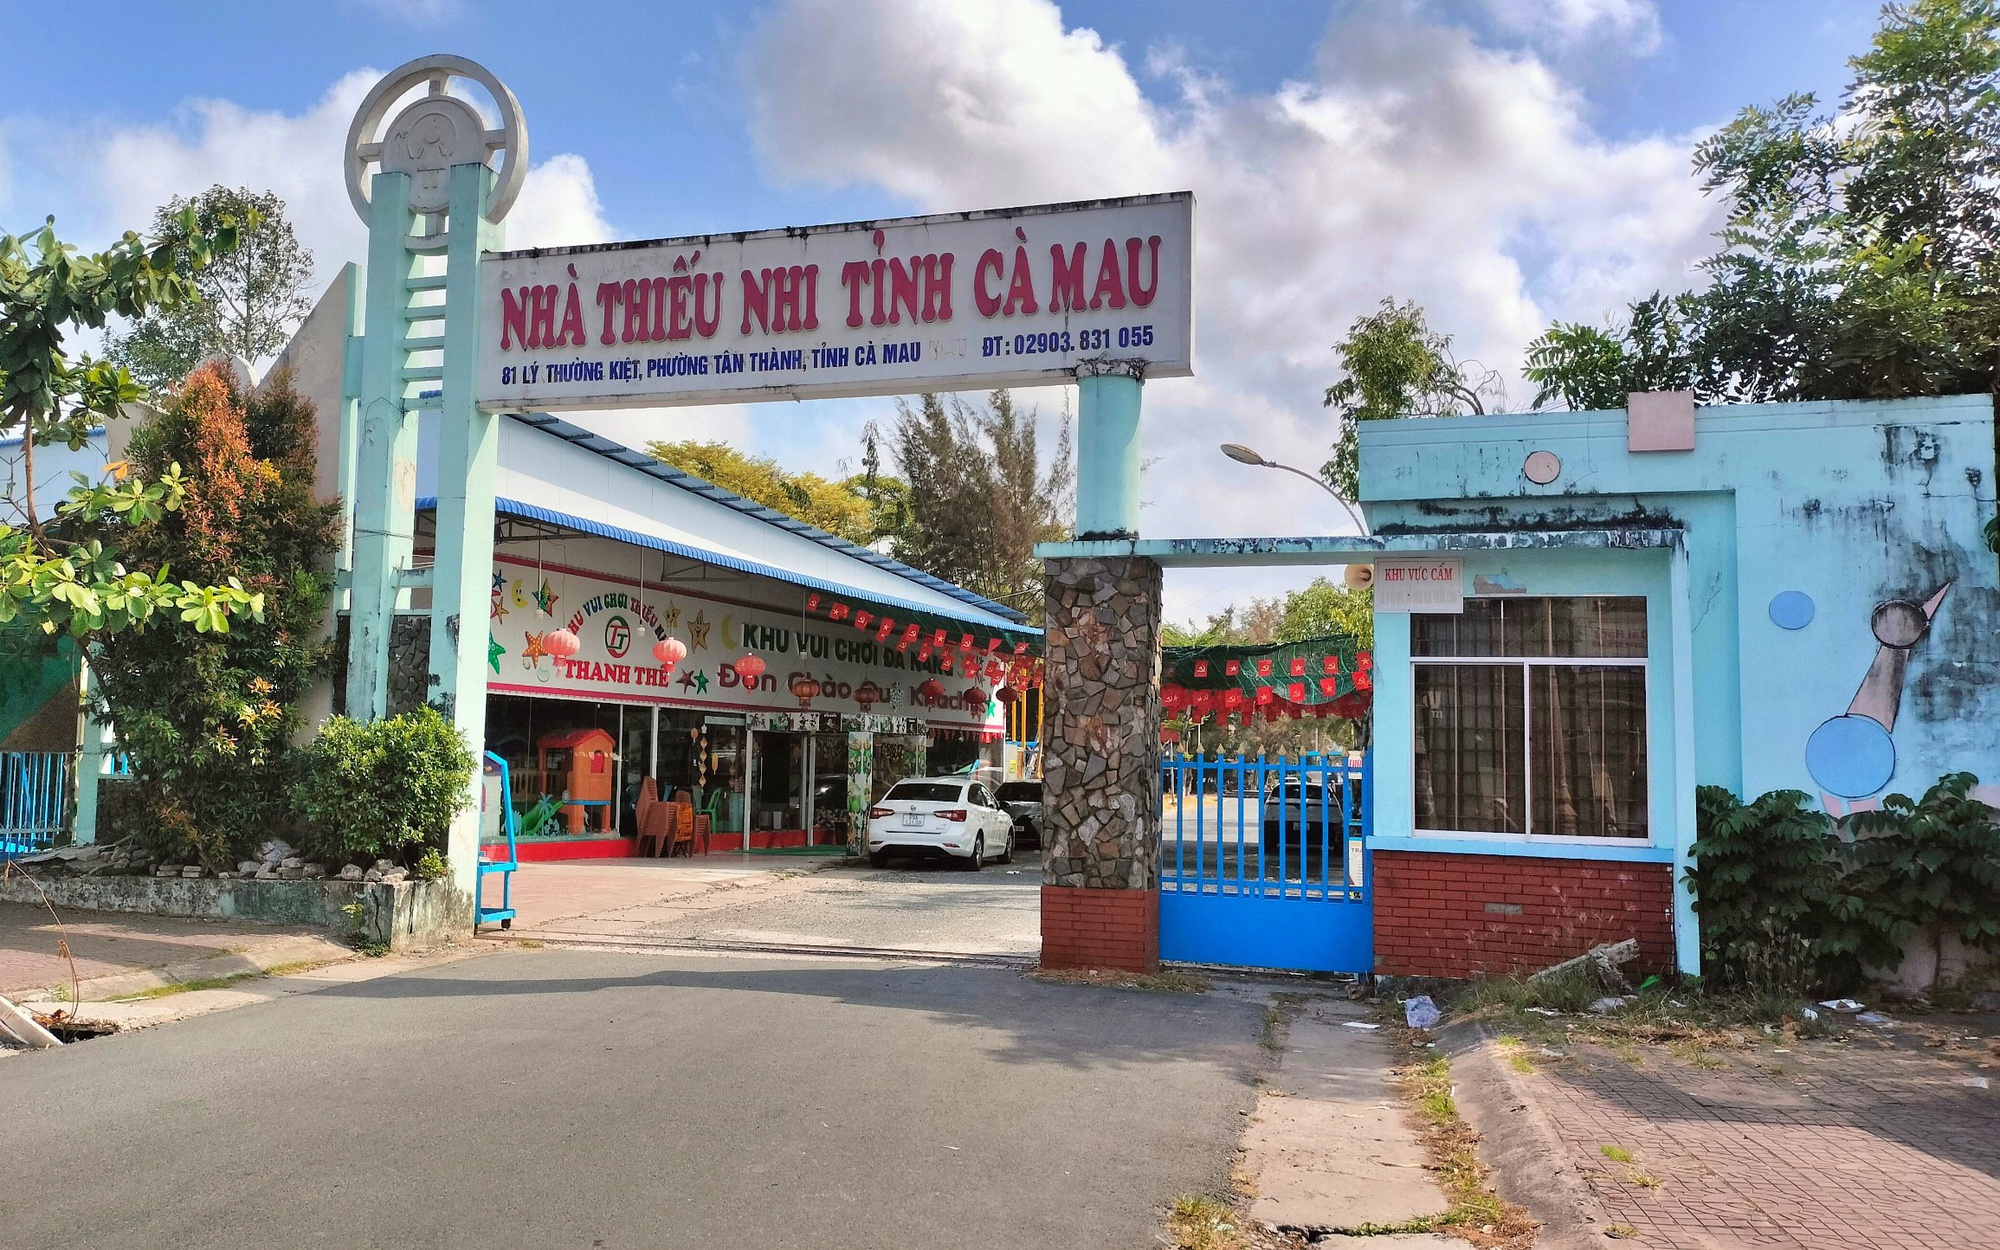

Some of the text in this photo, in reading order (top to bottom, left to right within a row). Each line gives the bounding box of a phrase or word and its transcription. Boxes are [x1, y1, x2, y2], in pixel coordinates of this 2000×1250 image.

[501, 226, 1162, 351] NHÀ THIẾU NHI TỈNH CÀ MAU
[1118, 325, 1153, 348] 055
[502, 366, 516, 385] 81
[522, 361, 540, 384] LÝ
[546, 357, 603, 383] THƯỜNG
[609, 357, 642, 382] KIỆT,
[647, 352, 708, 378] PHƯỜNG
[714, 350, 744, 374] TÂN
[750, 347, 807, 372] THÀNH,
[812, 342, 849, 368] TỈNH
[854, 341, 877, 366] CÀ
[882, 342, 921, 364] MAU
[1385, 562, 1453, 583] KHU VỰC CẤM
[568, 610, 584, 635] HU
[583, 596, 603, 617] VUI
[604, 591, 628, 609] CHƠI
[741, 623, 789, 653] KHU
[795, 631, 829, 659] VUI
[835, 638, 878, 666] CHƠI
[565, 660, 631, 684] THANH
[788, 671, 852, 699] Cào
